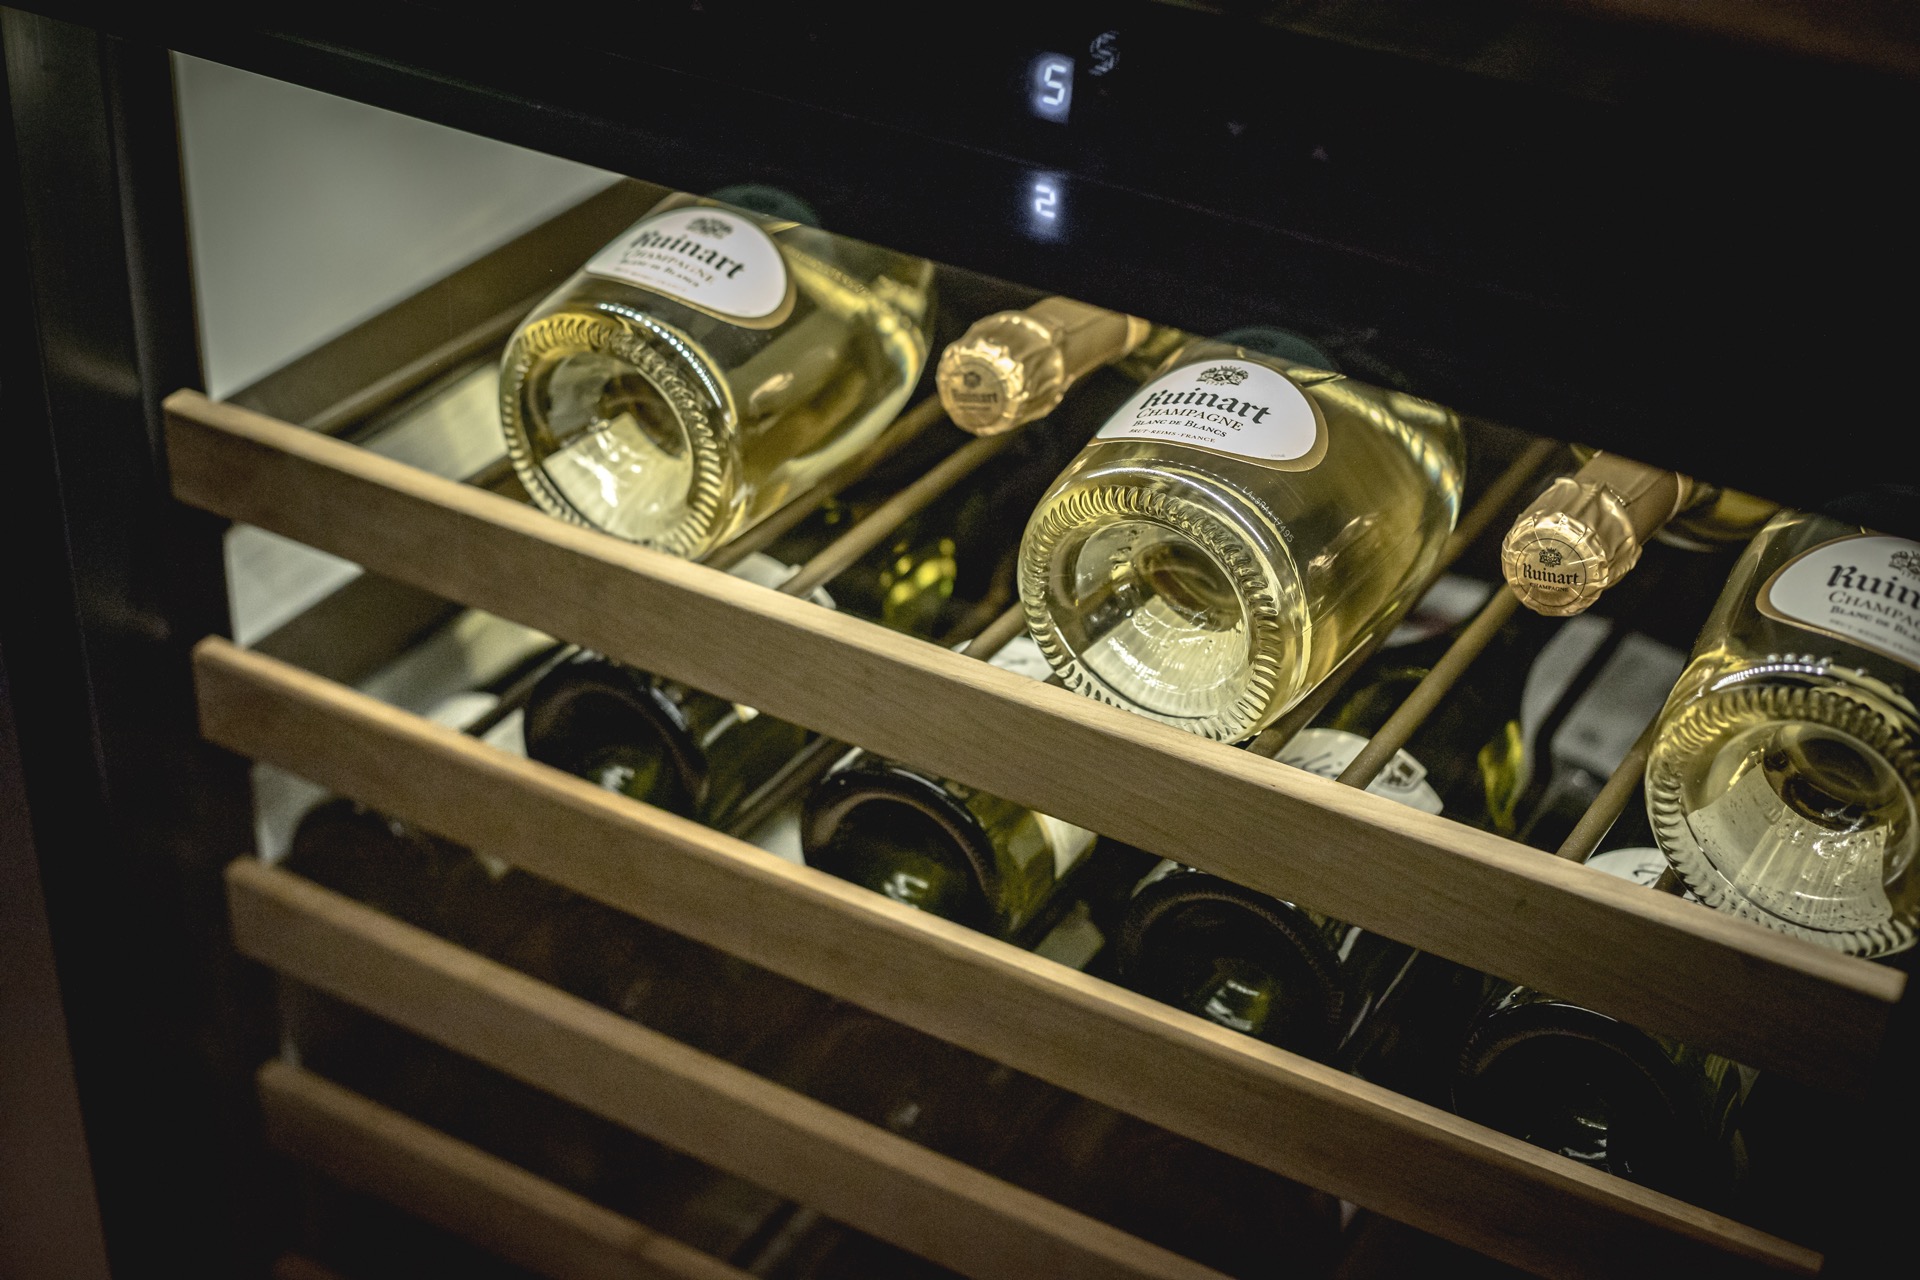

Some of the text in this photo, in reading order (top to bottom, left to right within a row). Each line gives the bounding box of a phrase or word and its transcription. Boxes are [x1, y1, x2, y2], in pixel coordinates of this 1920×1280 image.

[1043, 64, 1067, 105] 5
[630, 230, 745, 279] Ruinart
[1136, 407, 1244, 432] CHAMPAGNE
[1139, 388, 1272, 425] Ruinart
[1132, 419, 1168, 428] BLANC
[1184, 419, 1228, 438] BLANCS
[1522, 563, 1579, 586] Ruinart
